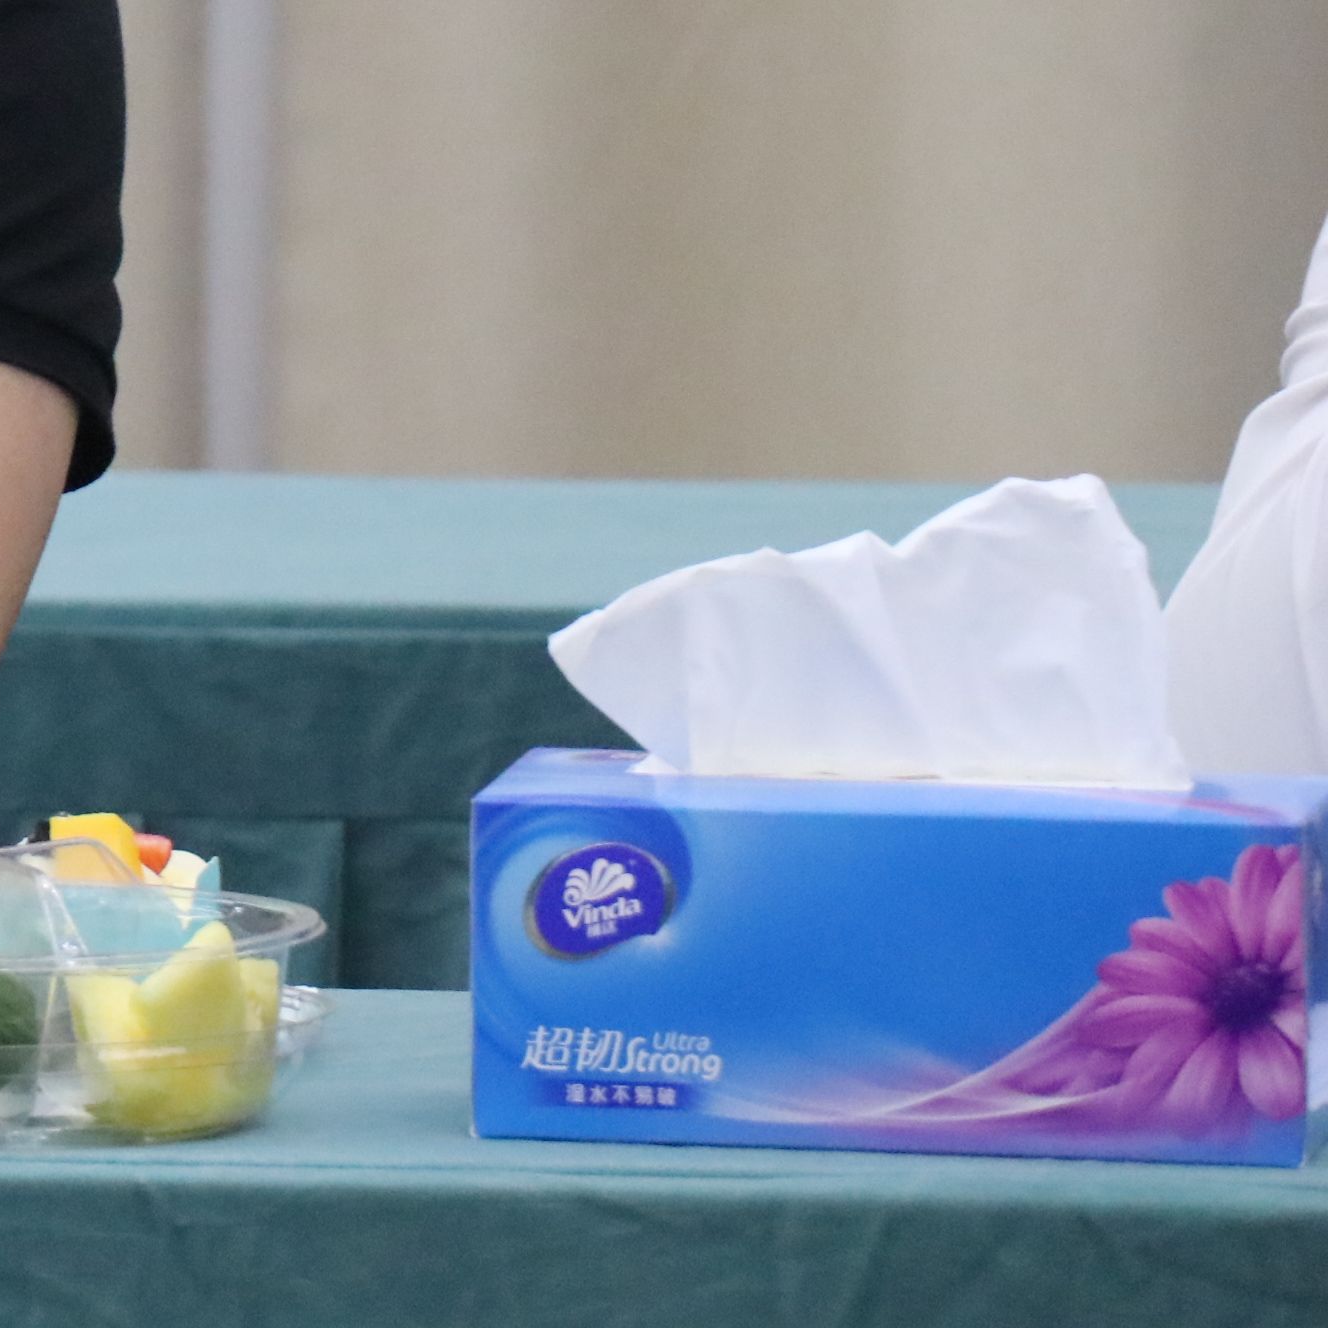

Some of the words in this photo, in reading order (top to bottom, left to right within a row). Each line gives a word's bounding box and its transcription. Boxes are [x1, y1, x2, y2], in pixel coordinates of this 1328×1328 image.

[561, 896, 642, 929] Vinda
[521, 1025, 624, 1072] 超韧
[618, 1036, 723, 1081] Strong
[652, 1031, 711, 1052] Ultra
